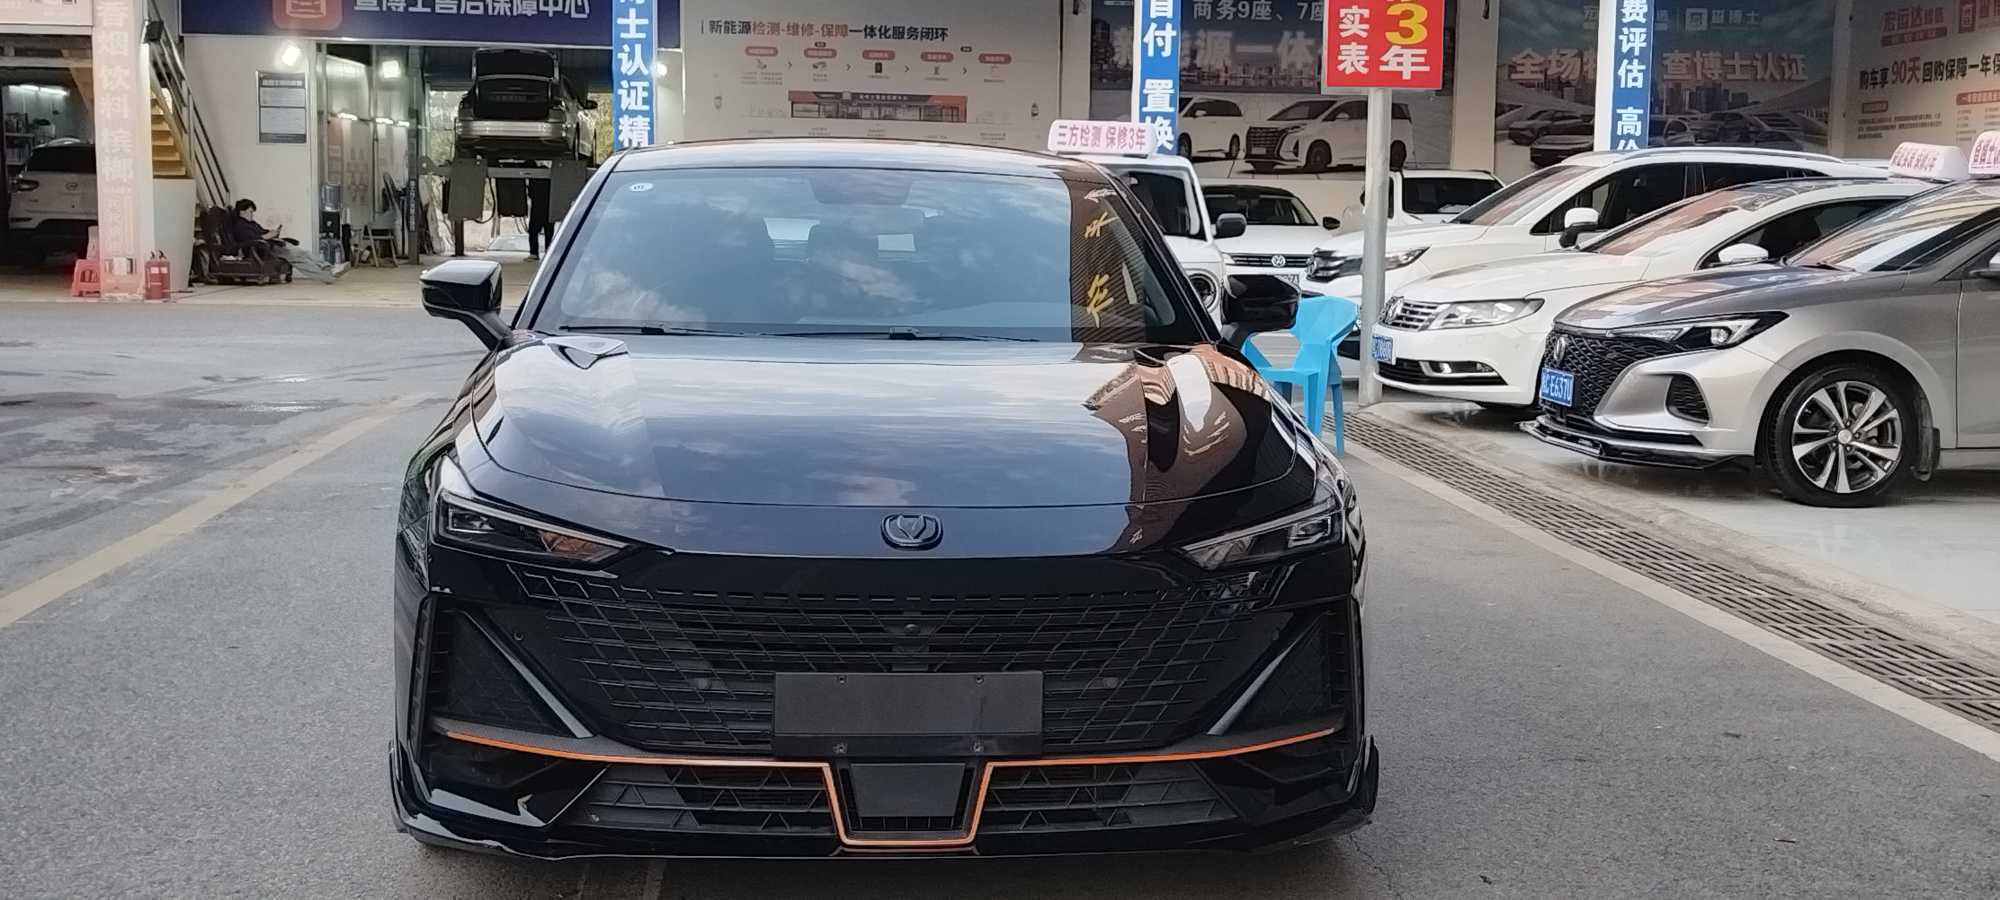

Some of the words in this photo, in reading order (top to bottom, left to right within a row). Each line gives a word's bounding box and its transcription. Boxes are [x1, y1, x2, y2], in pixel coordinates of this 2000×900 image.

[616, 0, 651, 147] 士认证精
[1337, 5, 1370, 75] 实表
[1617, 0, 1648, 88] 费评估
[1662, 50, 1809, 82] 查博士认证
[1057, 126, 1101, 148] 三方检测
[1105, 126, 1147, 150] 保修3年
[1141, 79, 1176, 150] 置换
